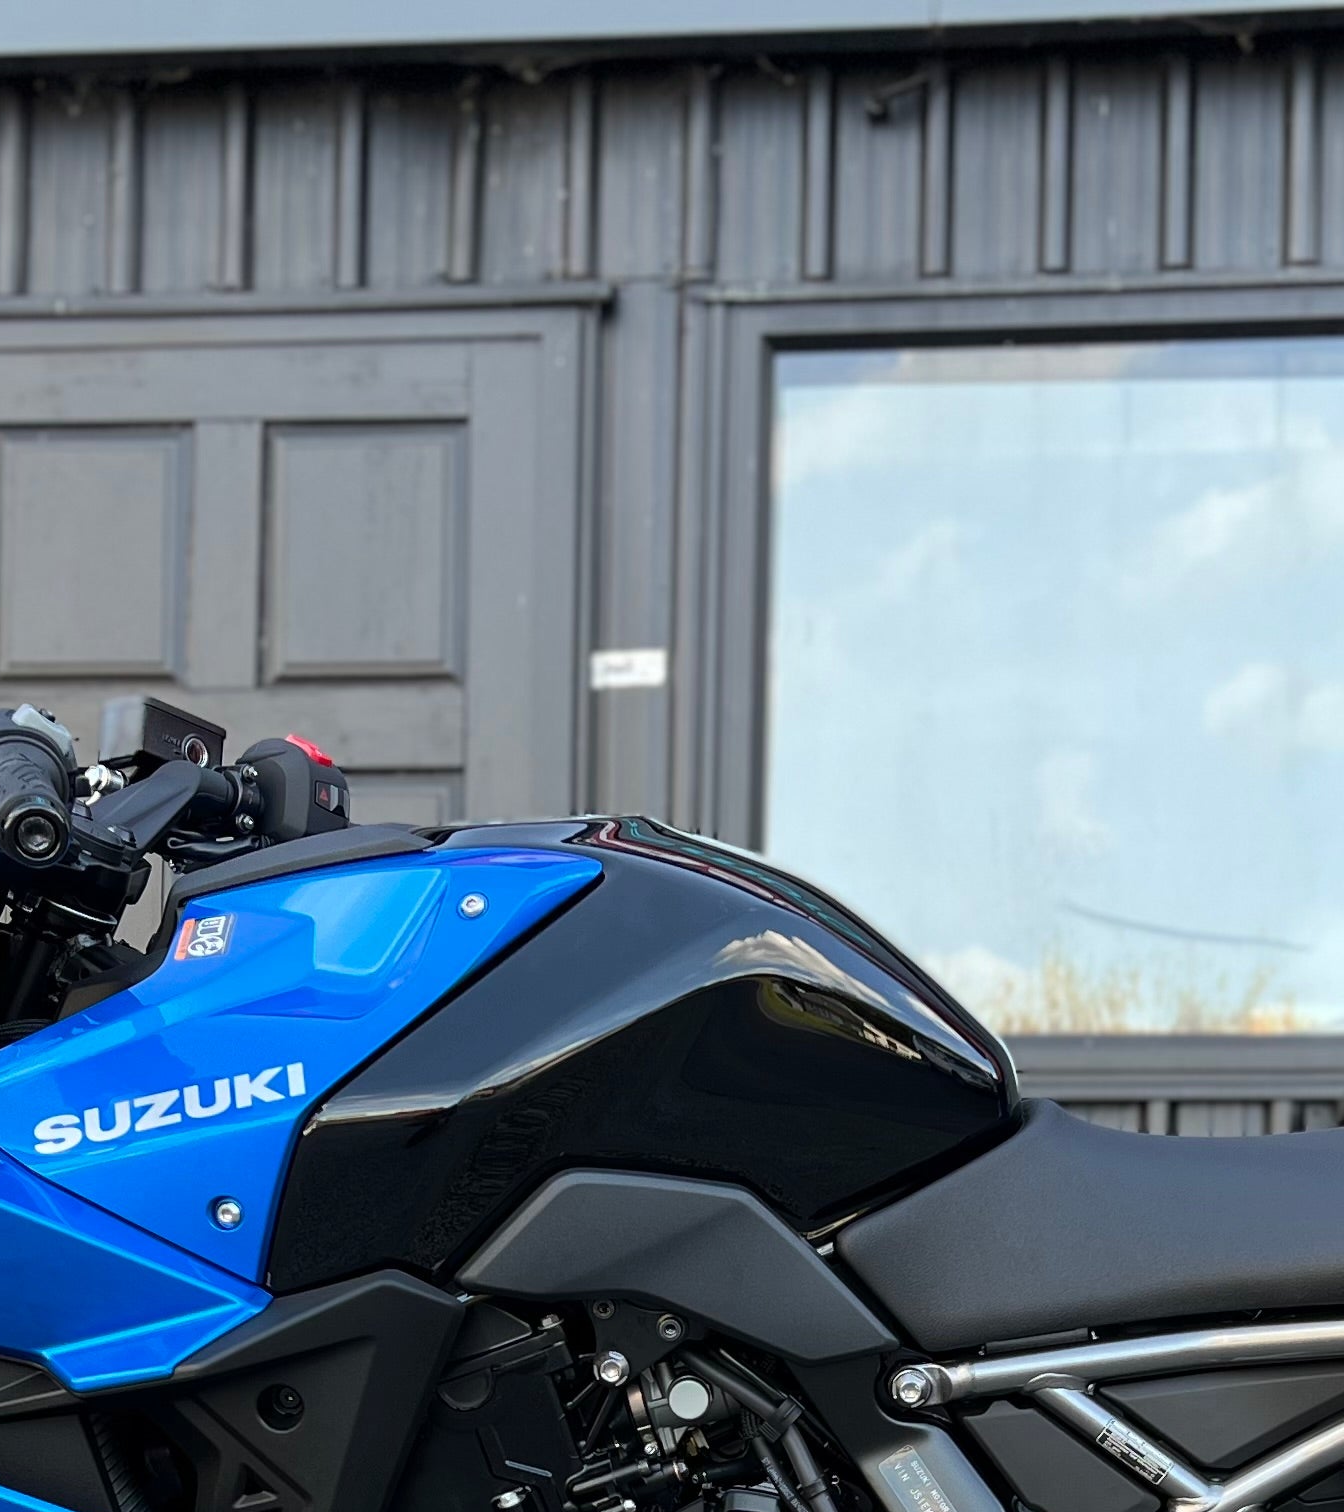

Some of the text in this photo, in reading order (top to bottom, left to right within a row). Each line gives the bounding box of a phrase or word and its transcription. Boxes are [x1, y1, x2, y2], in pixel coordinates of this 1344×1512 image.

[33, 1062, 306, 1154] SUZUKI
[893, 1462, 910, 1482] VIN
[929, 1489, 949, 1512] MOTOR
